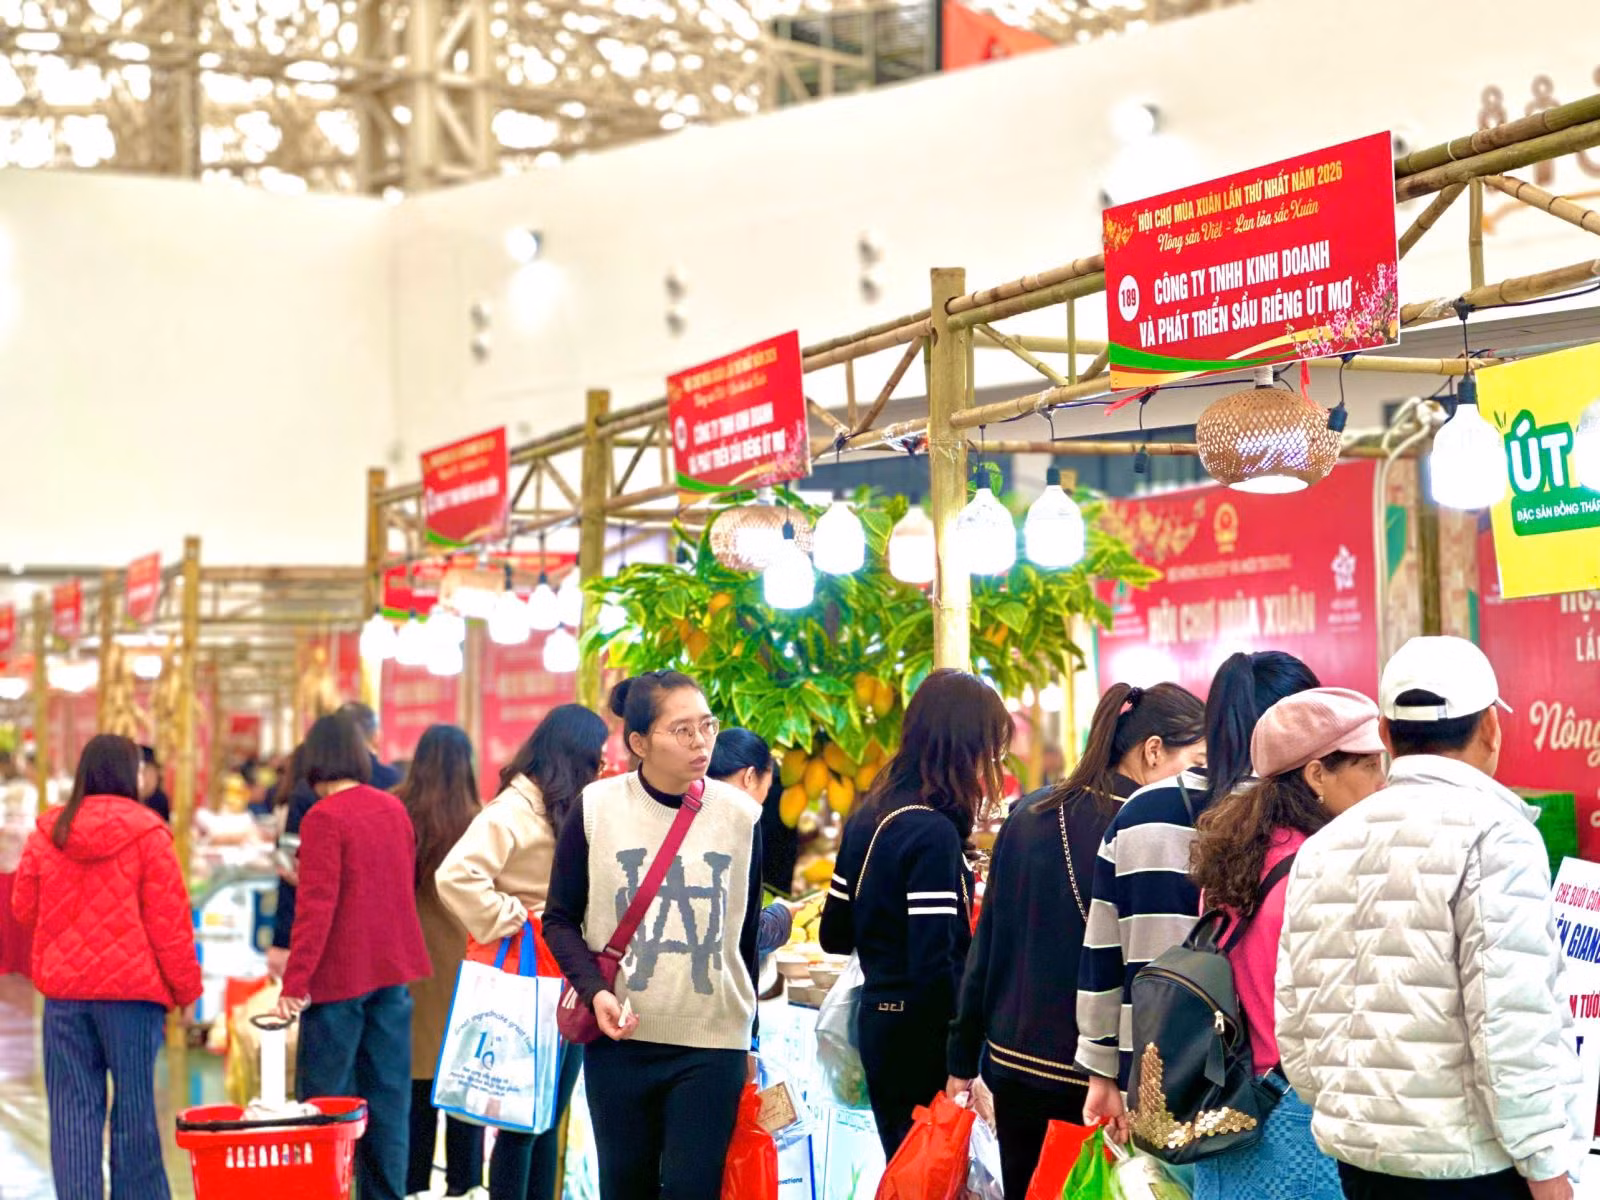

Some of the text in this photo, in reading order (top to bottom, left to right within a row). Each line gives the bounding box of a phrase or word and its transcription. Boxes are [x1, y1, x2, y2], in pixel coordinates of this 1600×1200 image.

[1138, 160, 1343, 234] HỘI CHỢ MÙA XUÂN LẦN THỨ NHẤT NĂM 2026
[1158, 232, 1183, 254] Nông
[1185, 228, 1201, 246] sản
[1201, 221, 1223, 242] Việt
[1234, 213, 1255, 235] Lan
[1273, 203, 1289, 223] sắc
[1290, 198, 1319, 220] Xuân
[1121, 288, 1136, 307] 189
[1154, 240, 1331, 305] CÔNG TY TNHH KINH DOANH
[1139, 276, 1353, 348] VÀ PHÁT TRIỂN SẦU RIÊNG ÚT MƠ
[1510, 418, 1569, 492] ÚT
[1516, 508, 1535, 523] ĐẶC
[1536, 504, 1553, 519] SẢN
[1554, 500, 1579, 517] ĐỒNG
